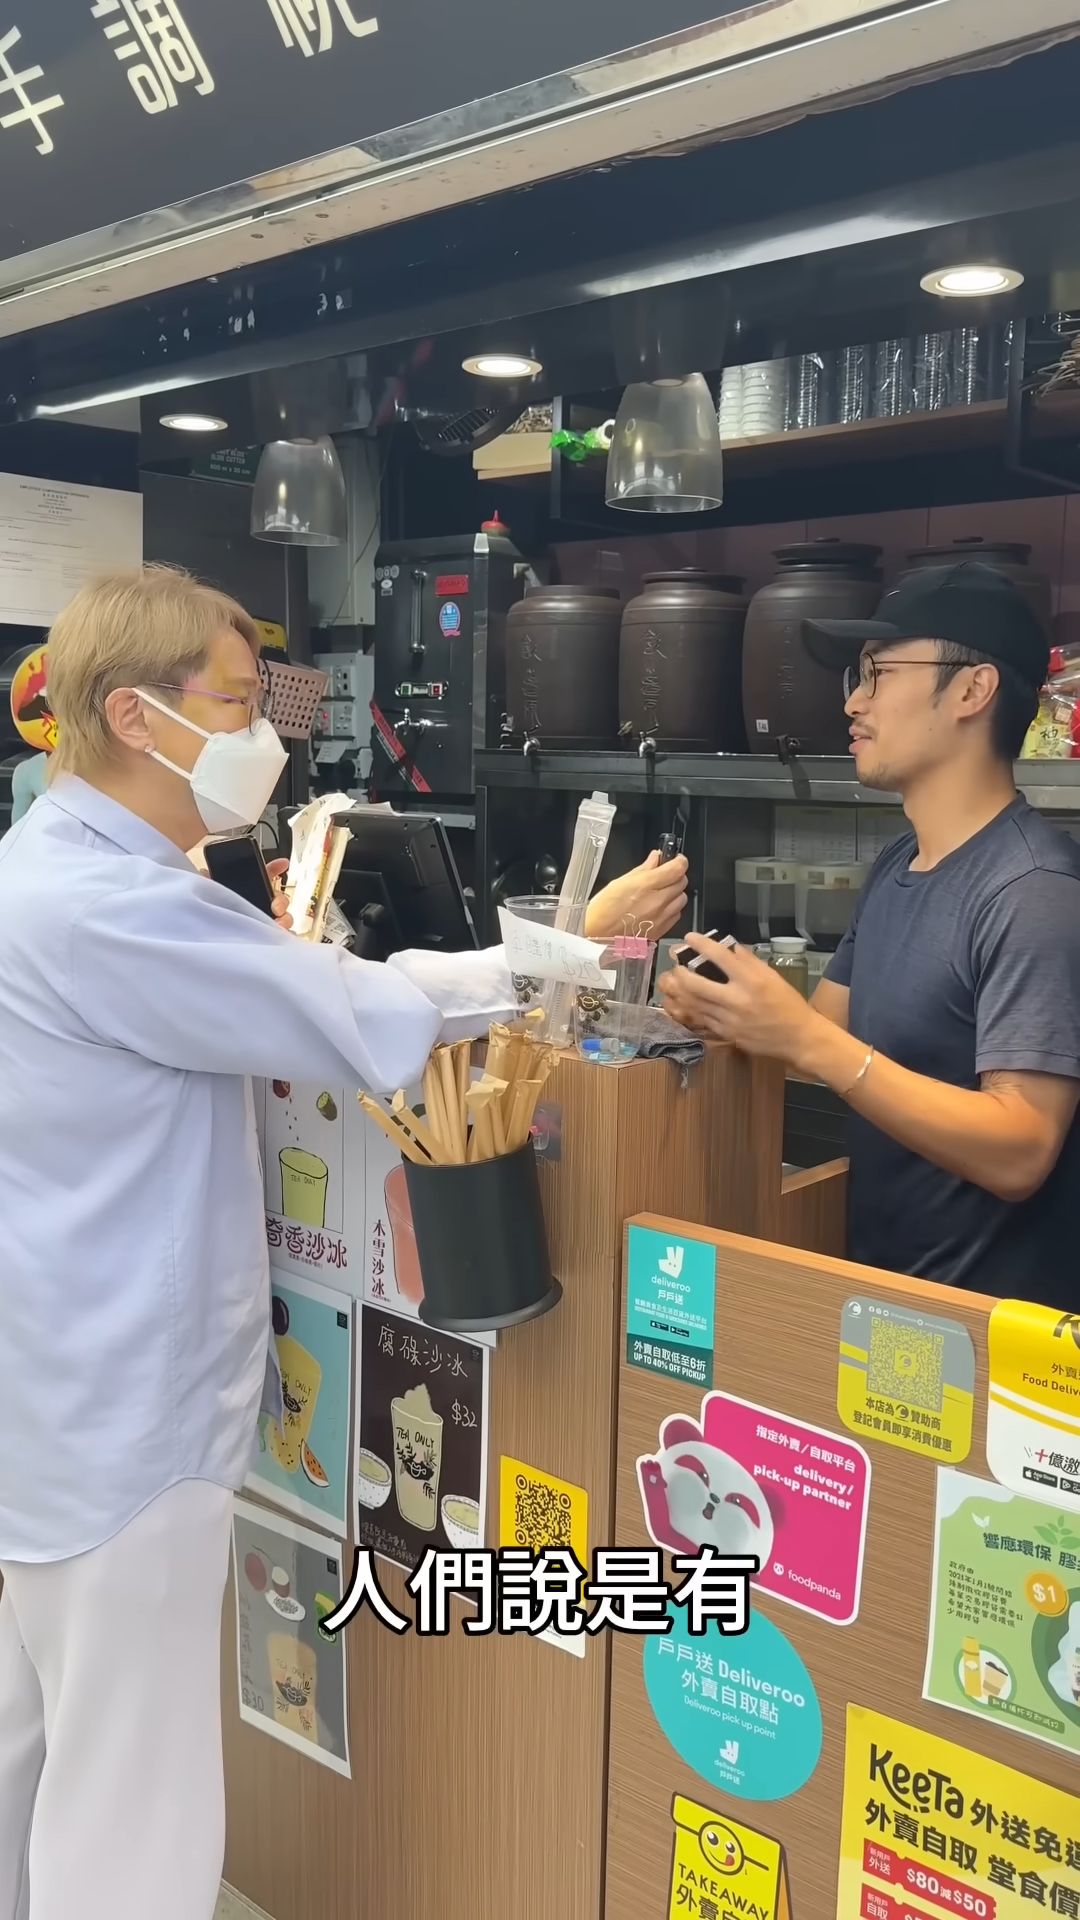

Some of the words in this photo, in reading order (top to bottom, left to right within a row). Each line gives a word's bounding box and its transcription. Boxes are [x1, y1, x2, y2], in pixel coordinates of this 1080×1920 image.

[371, 1219, 386, 1296] 木雪沙冰
[651, 1275, 691, 1293] deliveroo
[633, 1340, 706, 1373] 外賣自取低至6折
[633, 1352, 642, 1362] UP
[643, 1355, 652, 1366] TO
[652, 1358, 668, 1371] 40%
[669, 1363, 681, 1374] OFF
[682, 1366, 706, 1382] PICKUP
[1022, 1373, 1048, 1388] Food
[1051, 1381, 1080, 1396] Deliv
[1051, 1363, 1080, 1381] 外賣
[451, 1398, 478, 1428] $32
[865, 1397, 895, 1417] 本店為
[396, 1427, 410, 1442] TEA
[415, 1431, 435, 1449] ONLY
[853, 1410, 952, 1453] 登記會員即享消費優惠
[753, 1464, 800, 1492] pick-up
[803, 1483, 852, 1510] partner
[794, 1464, 854, 1496] delivery/
[949, 1561, 974, 1574] 政府由
[1058, 1551, 1080, 1573] 膠
[787, 1569, 842, 1601] foodpanda
[1032, 1582, 1056, 1603] $1
[681, 1669, 779, 1725] 外賣自取點
[718, 1659, 805, 1708] Deliveroo
[684, 1695, 721, 1717] Deliveroo
[722, 1711, 740, 1726] pick
[741, 1719, 753, 1731] up
[754, 1723, 776, 1740] point
[714, 1758, 746, 1777] deliveroo
[864, 1798, 978, 1875] 外賣自取
[868, 1856, 891, 1876] 外送
[678, 1862, 769, 1920] TAKEAWAY
[906, 1868, 987, 1918] $80減$50
[866, 1902, 889, 1920] 自取
